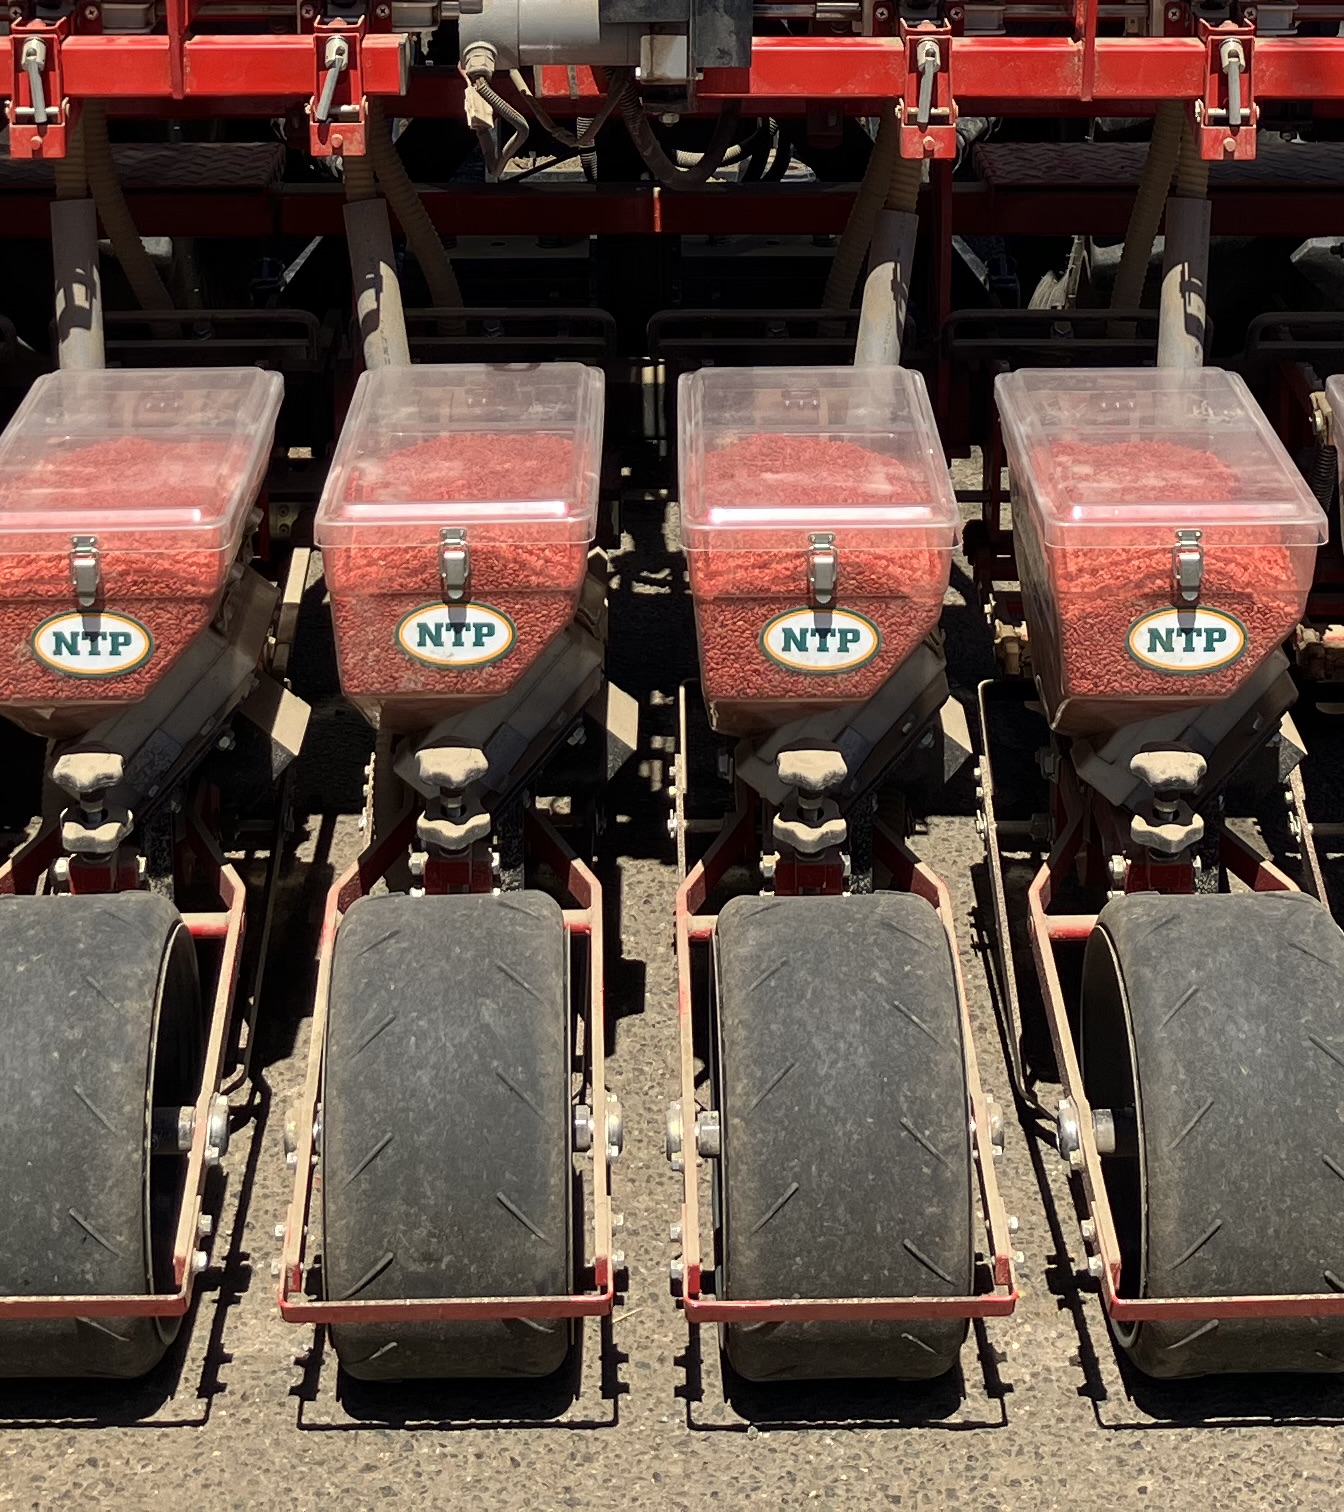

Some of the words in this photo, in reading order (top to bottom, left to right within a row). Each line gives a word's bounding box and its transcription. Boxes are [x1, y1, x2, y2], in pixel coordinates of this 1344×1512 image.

[52, 631, 132, 657] NTP
[416, 621, 497, 648] NTP
[781, 627, 862, 653] NTP
[1147, 627, 1227, 652] NTP
